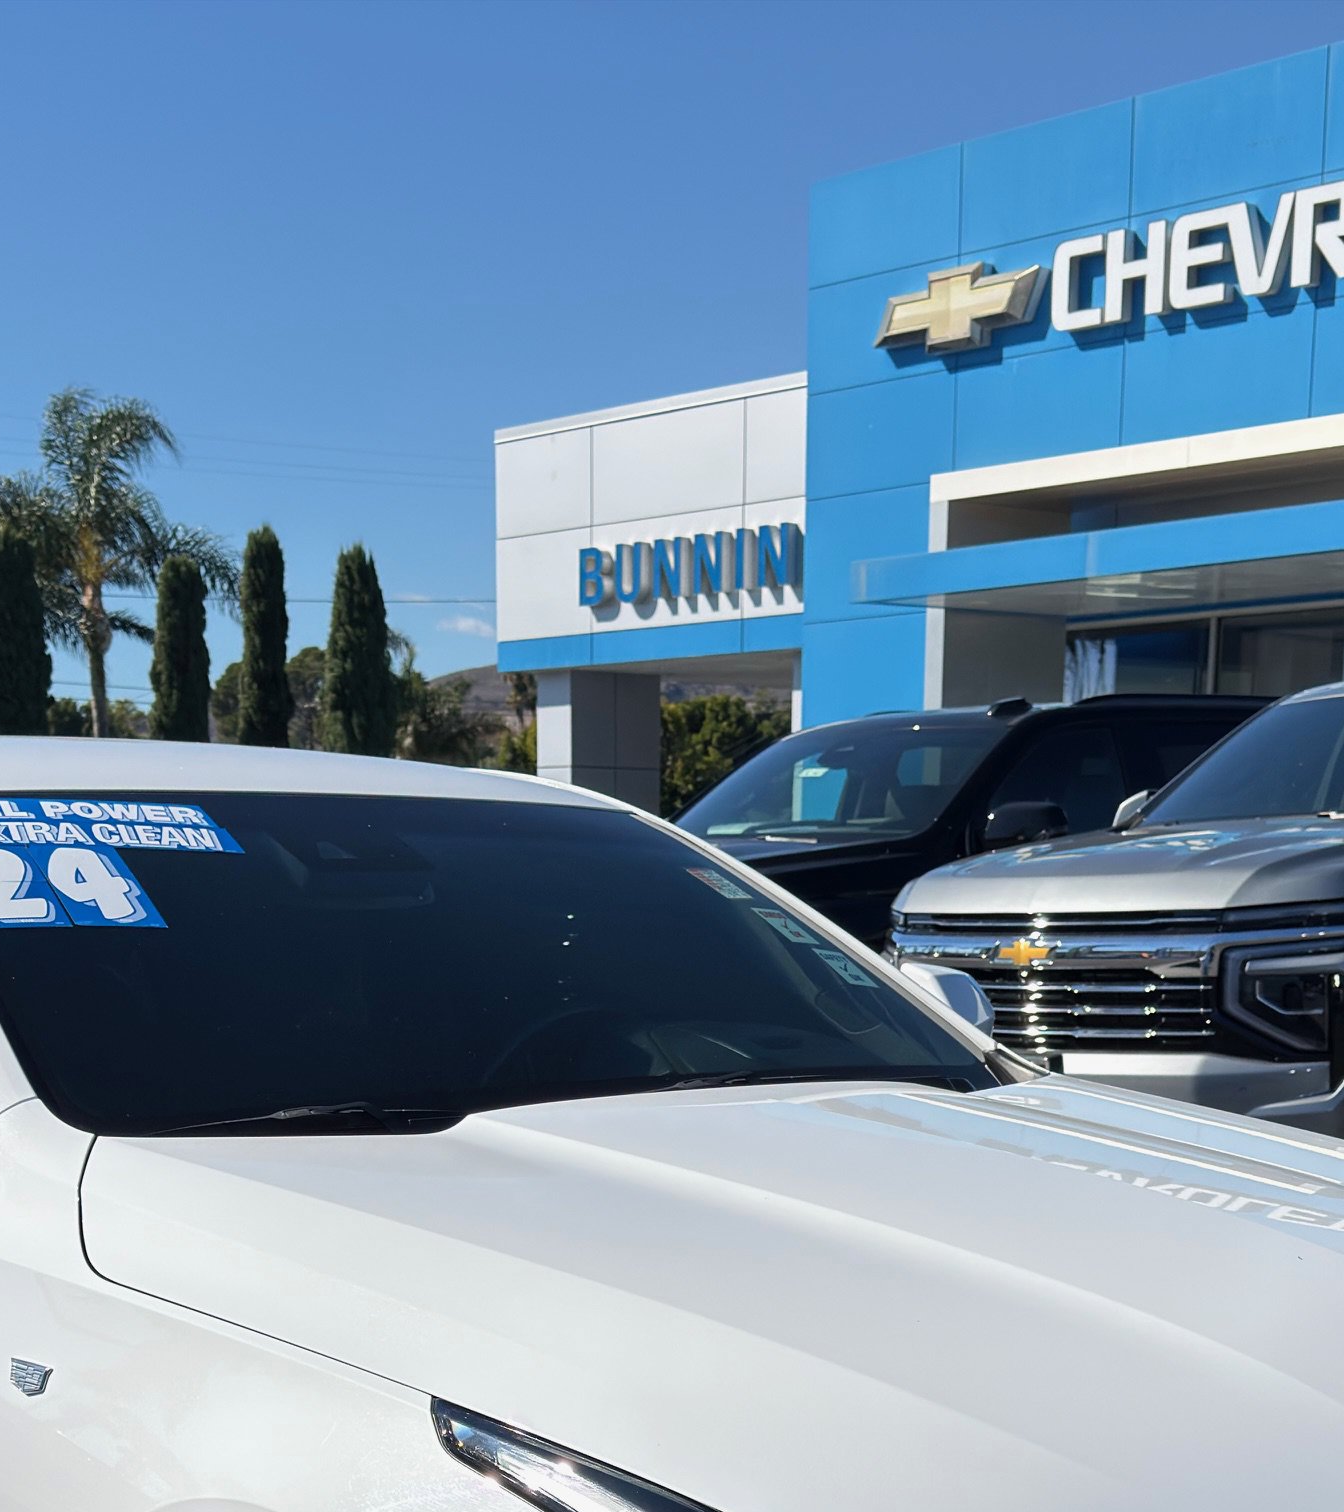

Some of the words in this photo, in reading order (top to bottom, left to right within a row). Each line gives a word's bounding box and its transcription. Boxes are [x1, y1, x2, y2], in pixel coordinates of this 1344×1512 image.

[578, 522, 796, 607] BUNNIN
[40, 801, 206, 825] POWER
[91, 823, 220, 849] CLEAN
